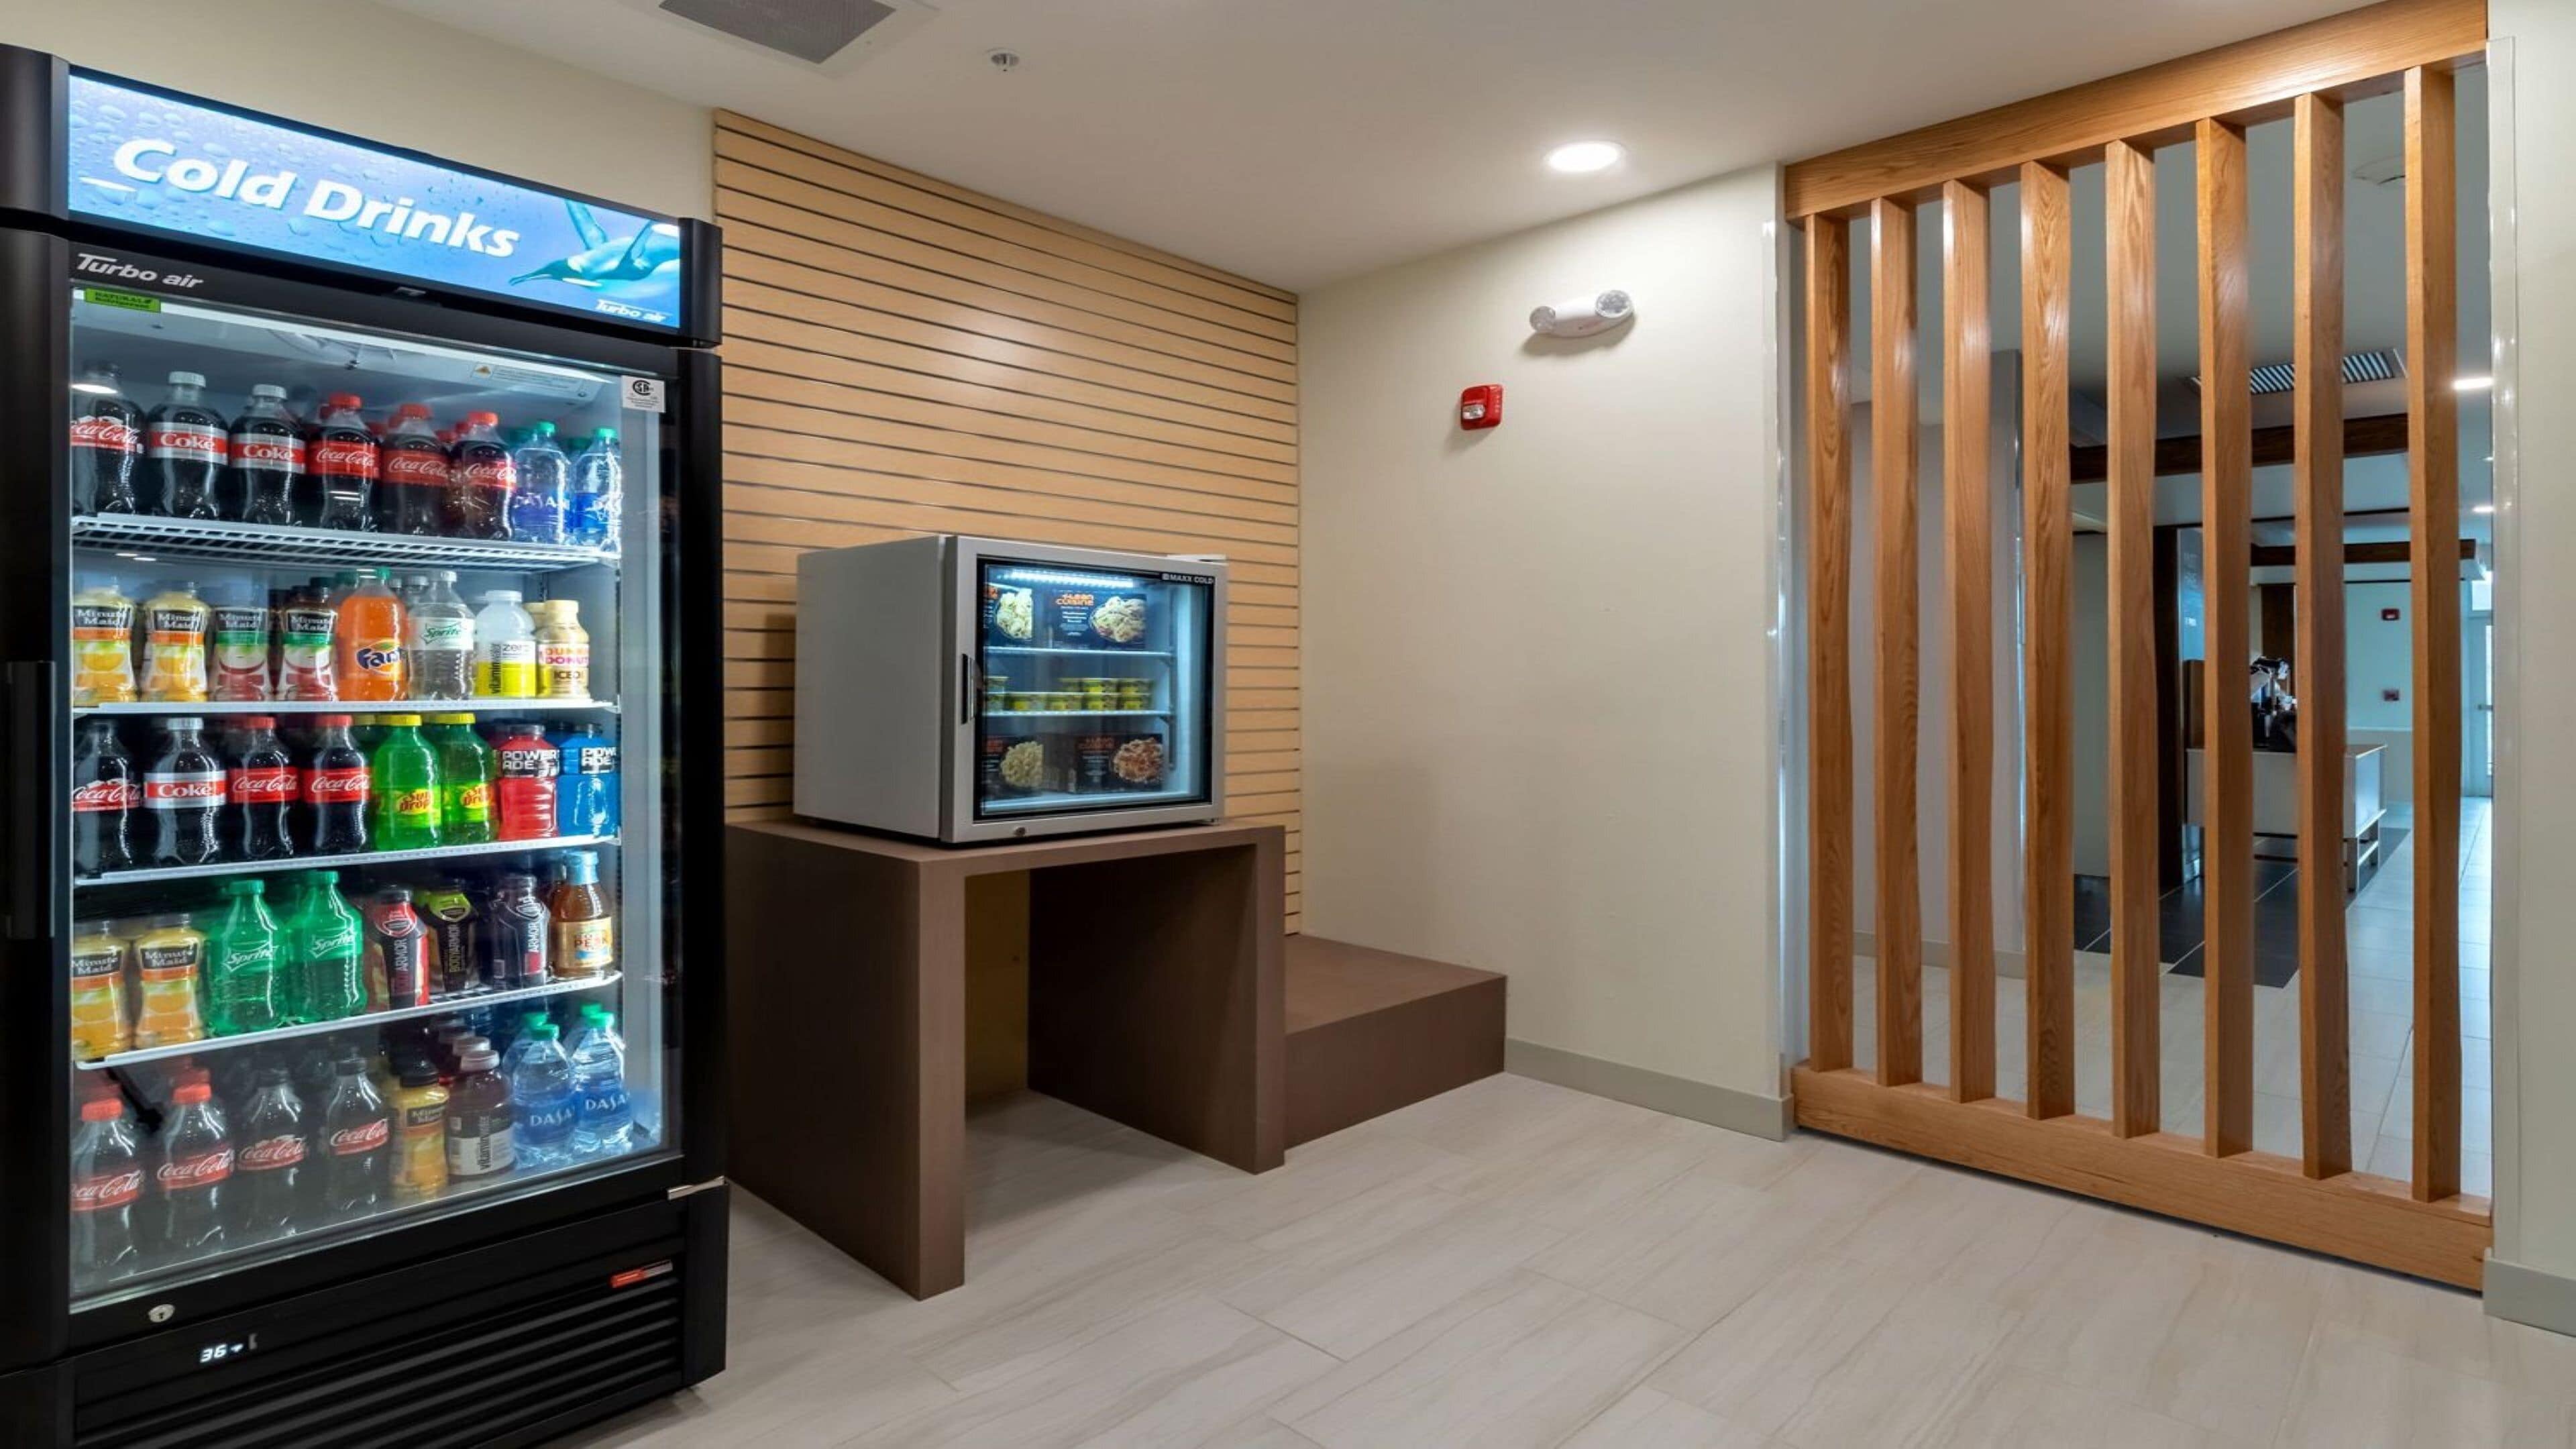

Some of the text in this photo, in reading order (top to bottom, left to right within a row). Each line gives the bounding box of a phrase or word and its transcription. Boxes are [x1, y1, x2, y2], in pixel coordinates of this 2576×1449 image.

[113, 139, 521, 258] Cold Drinks
[77, 253, 204, 288] Turbo air
[595, 299, 666, 323] Turbo air
[160, 433, 215, 450] Coke
[243, 443, 295, 460] Coke
[317, 447, 375, 467] Coca-Cola
[84, 616, 121, 627] Maid
[164, 621, 197, 631] Maid
[504, 750, 557, 761] POWER
[504, 760, 535, 769] ADE
[158, 783, 213, 797] Coke
[233, 775, 296, 792] Coca-Cola
[311, 775, 370, 792] Coca-Cola
[144, 949, 193, 962] Minute
[152, 957, 189, 967] Maid
[227, 948, 274, 964] Sprite
[78, 964, 112, 975] Maid
[157, 1148, 234, 1177] Coca-Cola
[200, 1344, 227, 1363] 36
